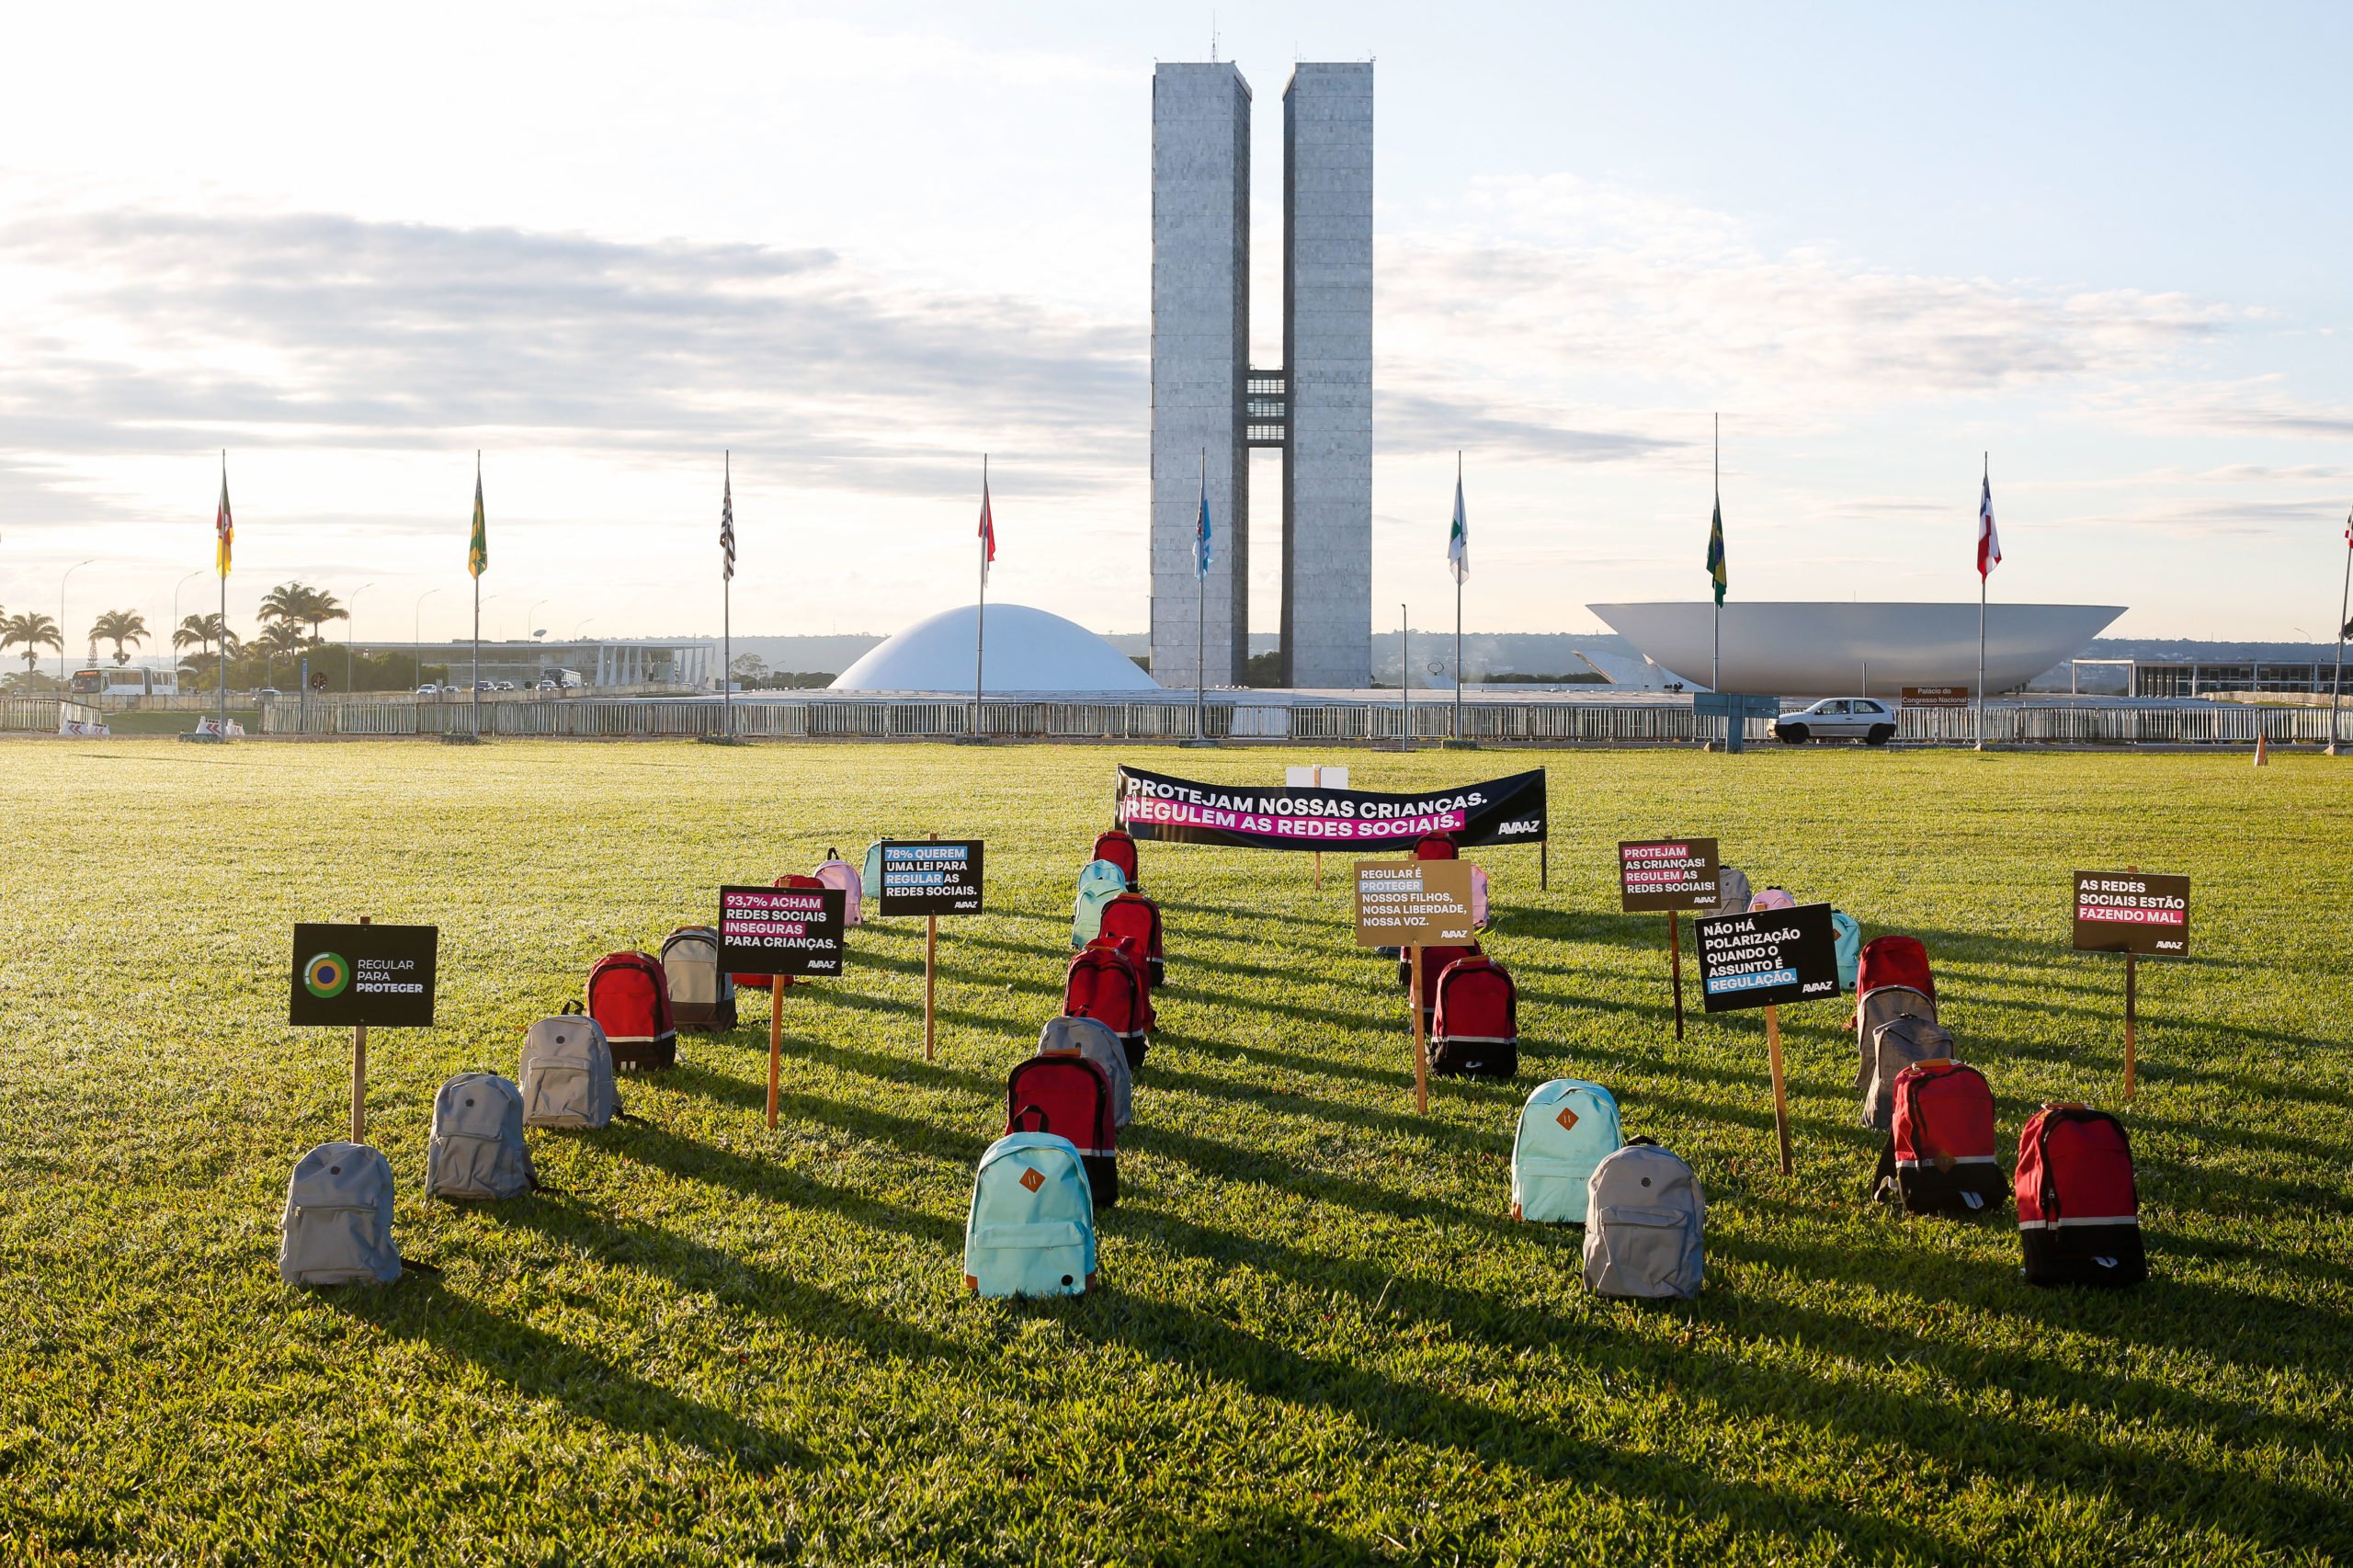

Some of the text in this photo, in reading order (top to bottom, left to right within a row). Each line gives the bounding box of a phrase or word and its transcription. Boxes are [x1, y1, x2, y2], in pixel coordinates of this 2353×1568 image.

[1127, 778, 1488, 820] PROTEJAM NOSSAS CRIANÇAS.
[1125, 800, 1461, 837] REGULEM AS REDES SOCIAIS.
[1497, 820, 1540, 835] AVAAZ
[886, 849, 965, 860] 78% QUEREM
[1624, 847, 1687, 858] PROTEJAM
[886, 861, 968, 871] UMA LEI PARA
[1625, 858, 1706, 870] AS CRIANÇAS!
[886, 874, 960, 884] REGULAR AS
[1361, 868, 1422, 879] REGULAR É
[1626, 870, 1698, 881] REGULEM AS
[886, 886, 978, 897] REDES SOCIAIS.
[1362, 881, 1420, 891] PROTEGER
[1628, 881, 1715, 893] REDES SOCIAIS!
[2080, 880, 2146, 892] AS REDES
[727, 895, 821, 909] 93,7% ACHAM
[1362, 893, 1453, 903] NOSSOS FILHOS,
[2080, 893, 2185, 909] SOCIAIS ESTÃO
[955, 901, 978, 909] AVAAZ
[1362, 904, 1467, 915] NOSSA LIBERDADE,
[726, 909, 827, 922] REDES SOCIAIS
[2080, 908, 2182, 924] FAZENDO MAL.
[1364, 917, 1429, 926] NOSSA VOZ.
[726, 923, 803, 935] INSEGURAS
[1704, 918, 1756, 937] NÃO HÁ
[1441, 930, 1468, 938] AVAAZ
[1705, 927, 1801, 950] POLARIZAÇÃO
[725, 936, 837, 950] PARA CRIANÇAS.
[2156, 940, 2183, 949] AVAAZ
[1707, 946, 1779, 965] QUANDO O
[358, 960, 415, 970] REGULAR
[807, 960, 836, 969] AVAAZ
[1709, 957, 1784, 978] ASSUNTO É
[358, 971, 391, 982] PARA
[1711, 971, 1796, 992] REGULAÇÃO.
[357, 983, 424, 994] PROTEGER
[1802, 981, 1834, 994] AVAAZ
